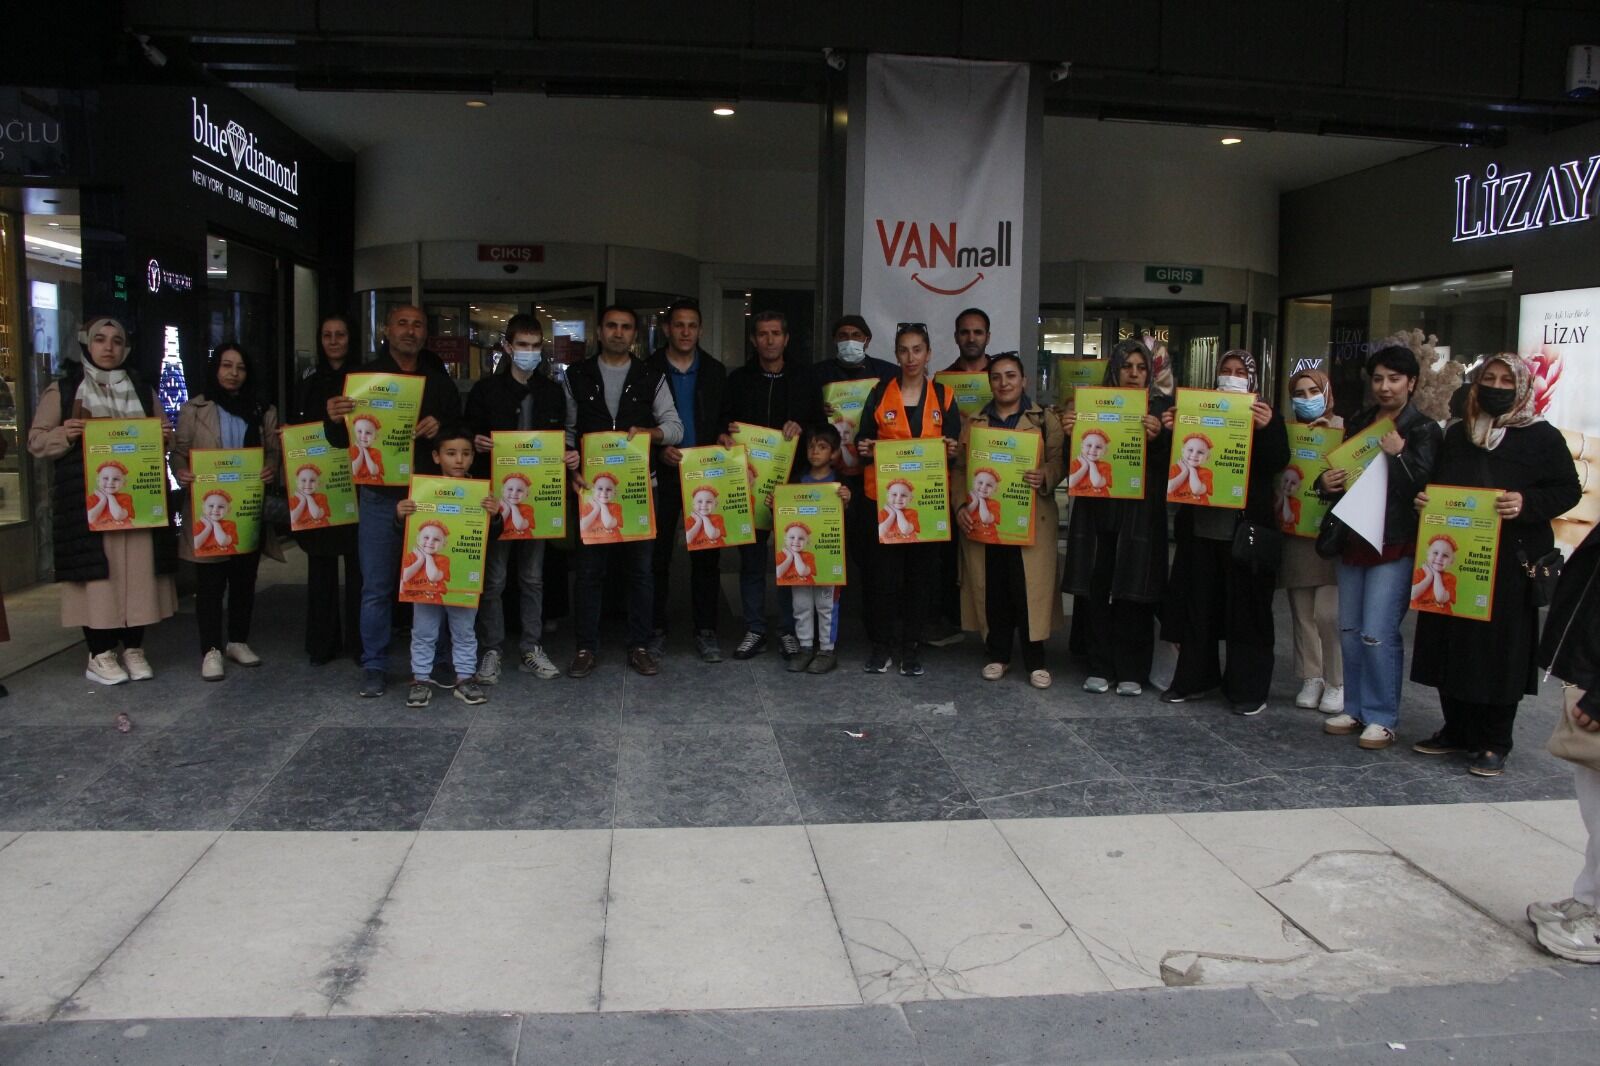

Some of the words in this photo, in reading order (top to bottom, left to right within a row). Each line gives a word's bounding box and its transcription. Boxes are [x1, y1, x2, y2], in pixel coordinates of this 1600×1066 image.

[0, 119, 59, 144] ĞLU
[192, 96, 228, 157] blue
[245, 132, 298, 196] diamond
[192, 169, 208, 187] NEW
[207, 176, 224, 196] YORK
[227, 186, 244, 205] DUBAI
[247, 195, 276, 219] AMSTERDAM
[1452, 160, 1600, 242] LİZAY
[490, 247, 532, 261] ÇIKIŞ
[1156, 266, 1193, 283] GİRİŞ
[1543, 322, 1589, 345] LİZAY
[434, 489, 456, 497] LÖSEV
[1445, 500, 1466, 508] LÖSEV
[451, 547, 481, 555] Çocuklara
[1468, 552, 1491, 560] Kurban
[1464, 558, 1491, 567] Lösemili
[1458, 566, 1489, 575] Çocuklara
[1475, 574, 1489, 582] CAN
